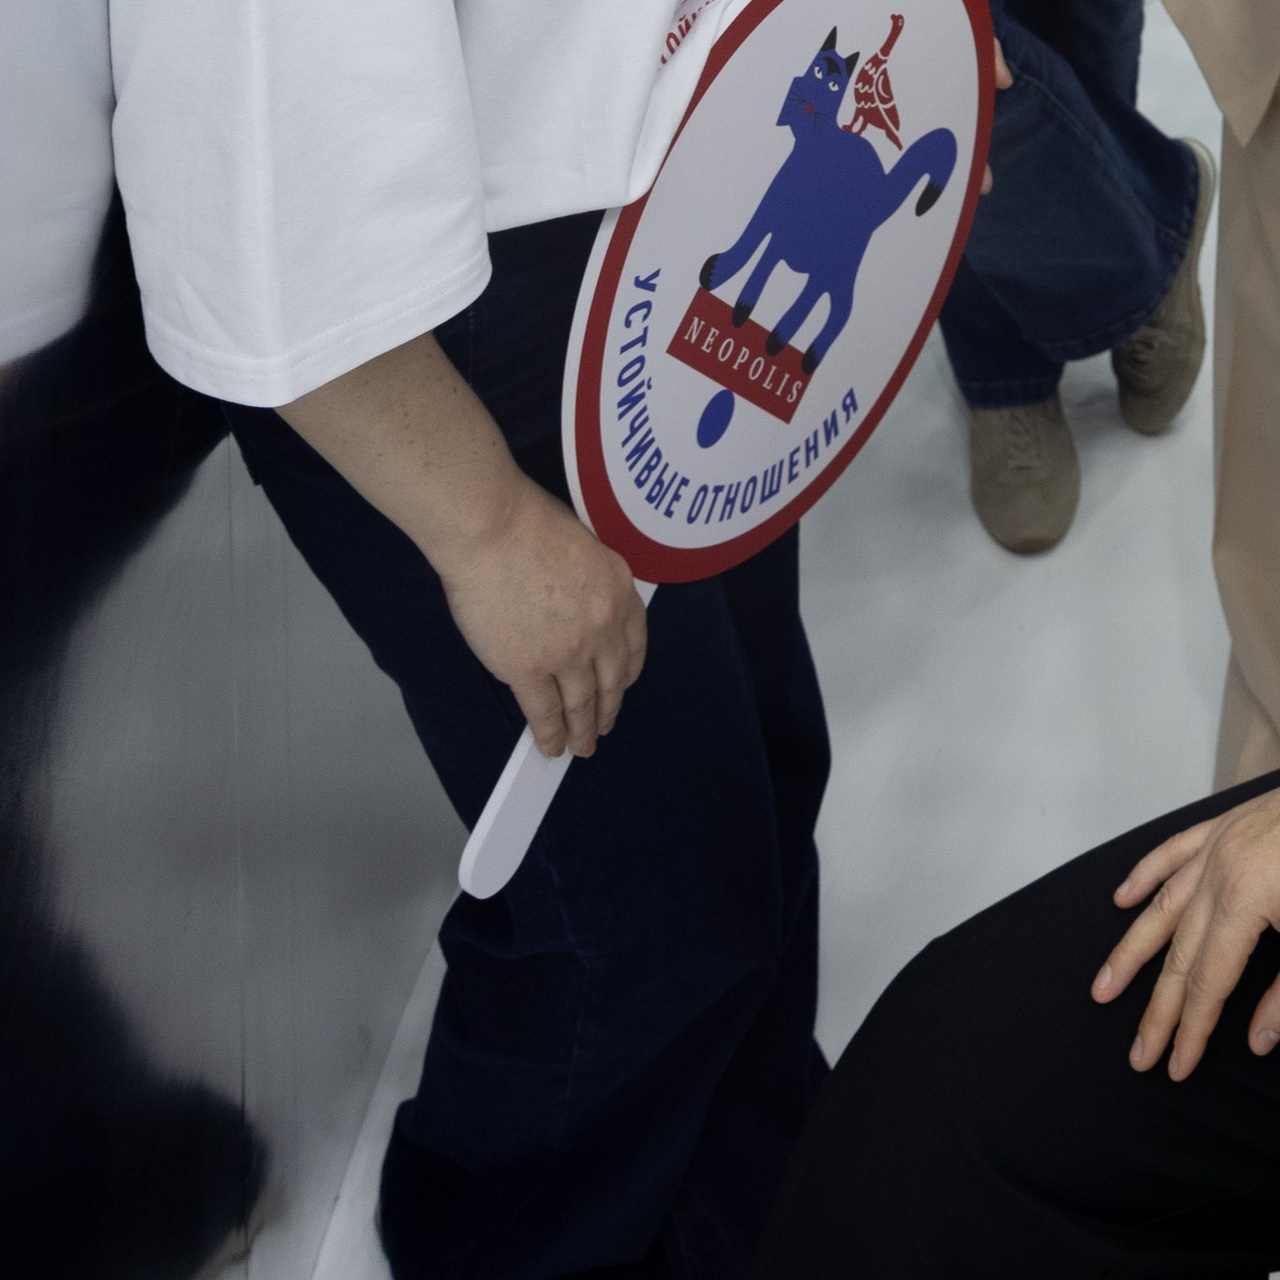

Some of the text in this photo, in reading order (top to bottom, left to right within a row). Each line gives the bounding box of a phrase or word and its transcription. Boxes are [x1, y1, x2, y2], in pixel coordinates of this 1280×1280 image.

[615, 267, 859, 526] УСТОЙЧИВЫЕ ОТНОШЕНИЯ
[684, 315, 803, 407] NEOPOLIS
